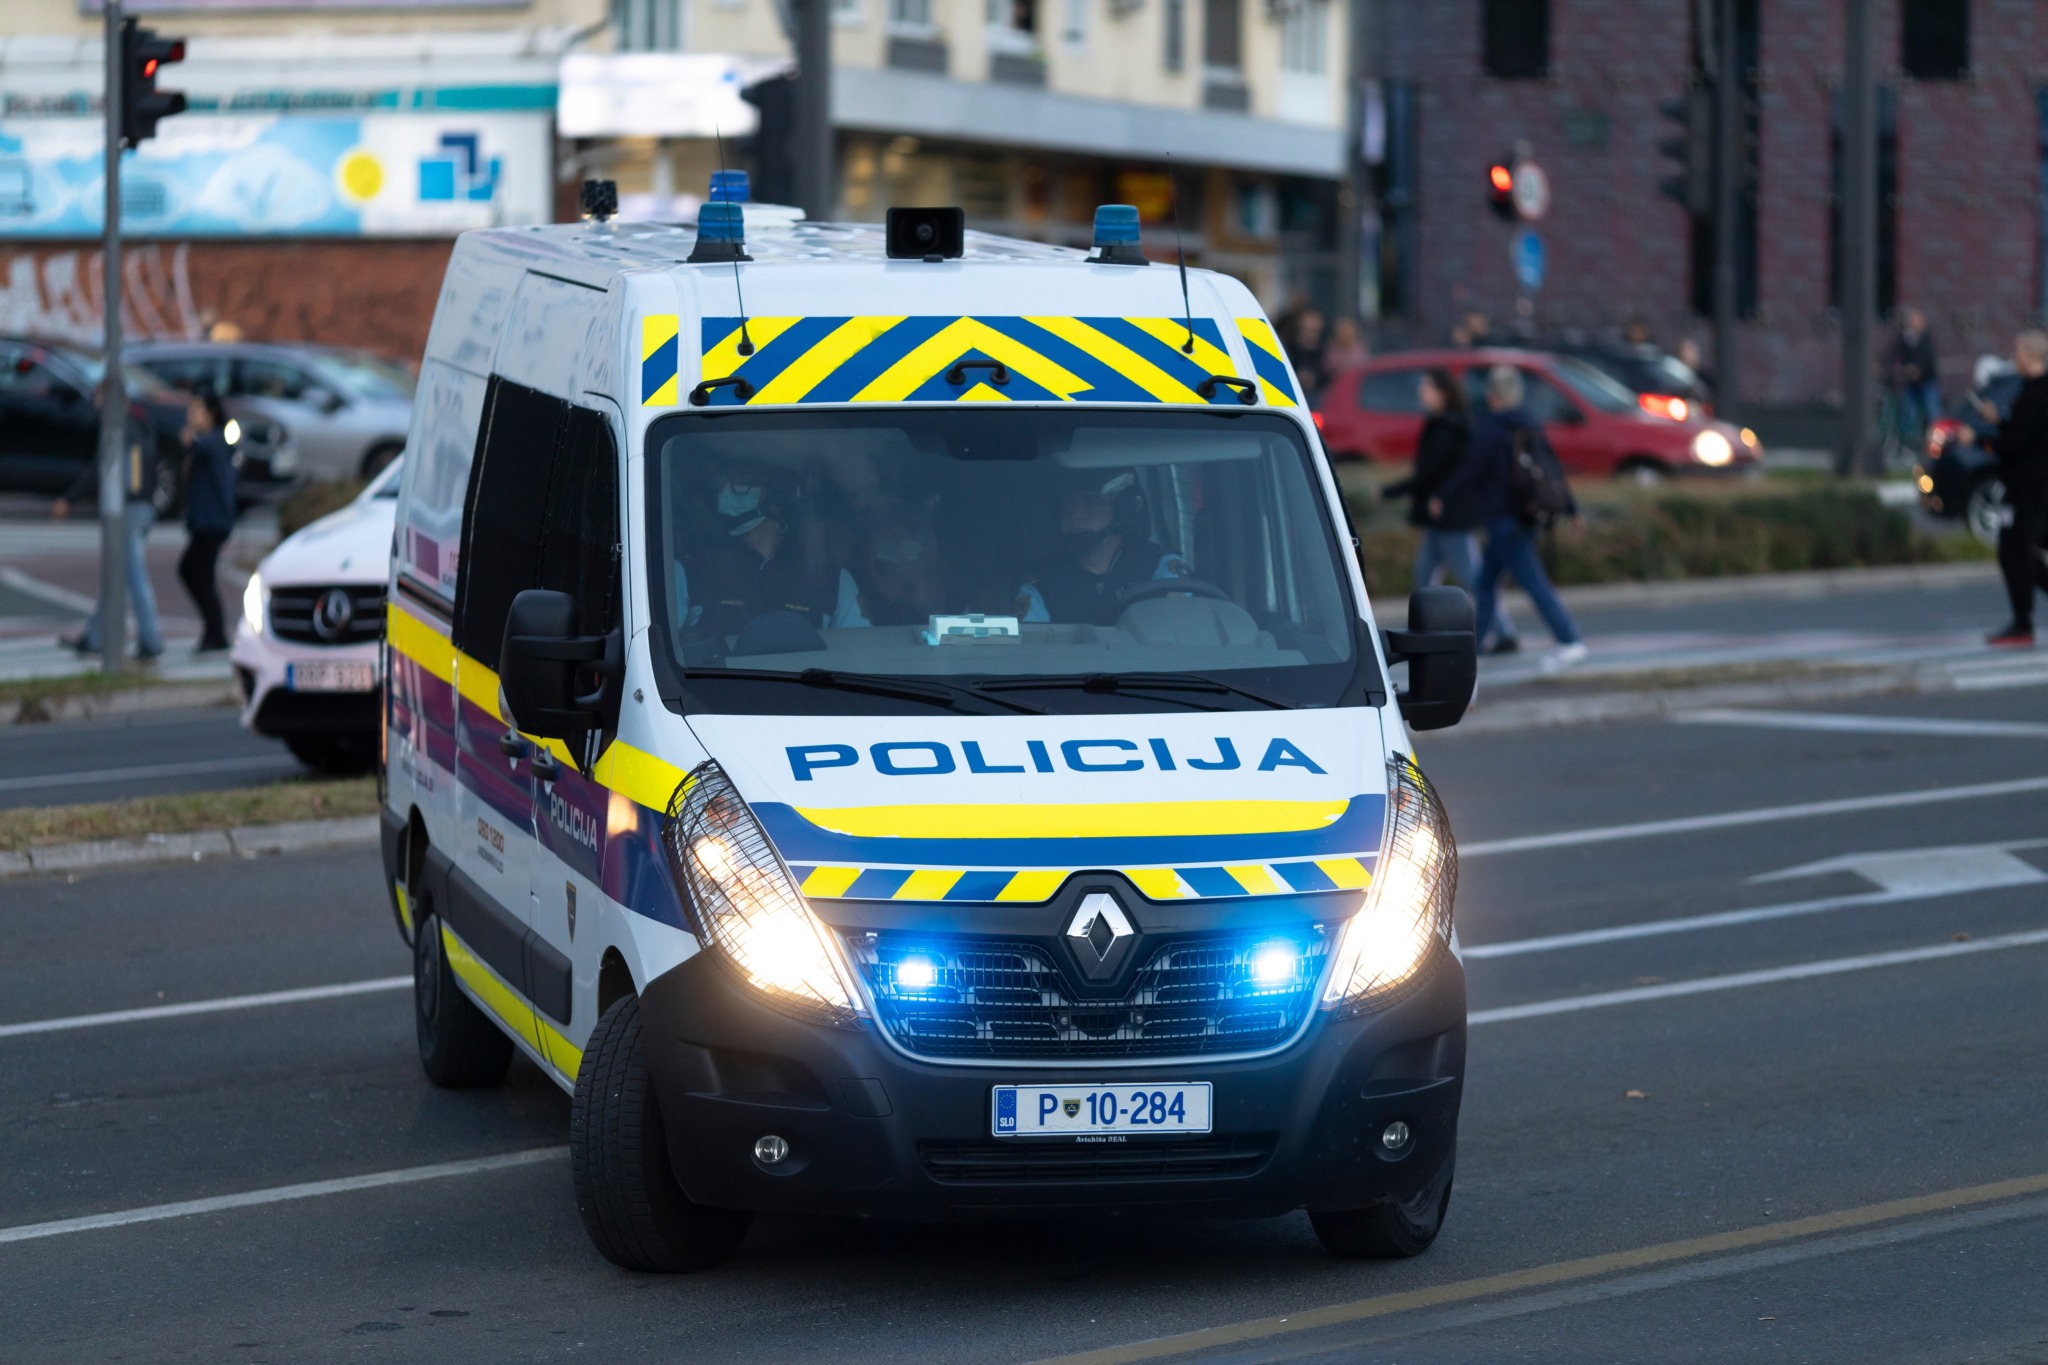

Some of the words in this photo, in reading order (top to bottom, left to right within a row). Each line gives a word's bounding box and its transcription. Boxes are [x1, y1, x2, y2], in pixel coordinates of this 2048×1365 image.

[785, 737, 1329, 781] POLICIJA
[550, 793, 598, 852] POLICIJA
[1000, 1117, 1015, 1127] SLO
[1039, 1093, 1058, 1126] P
[1086, 1090, 1186, 1126] 10-284
[1107, 1135, 1128, 1143] REAL
